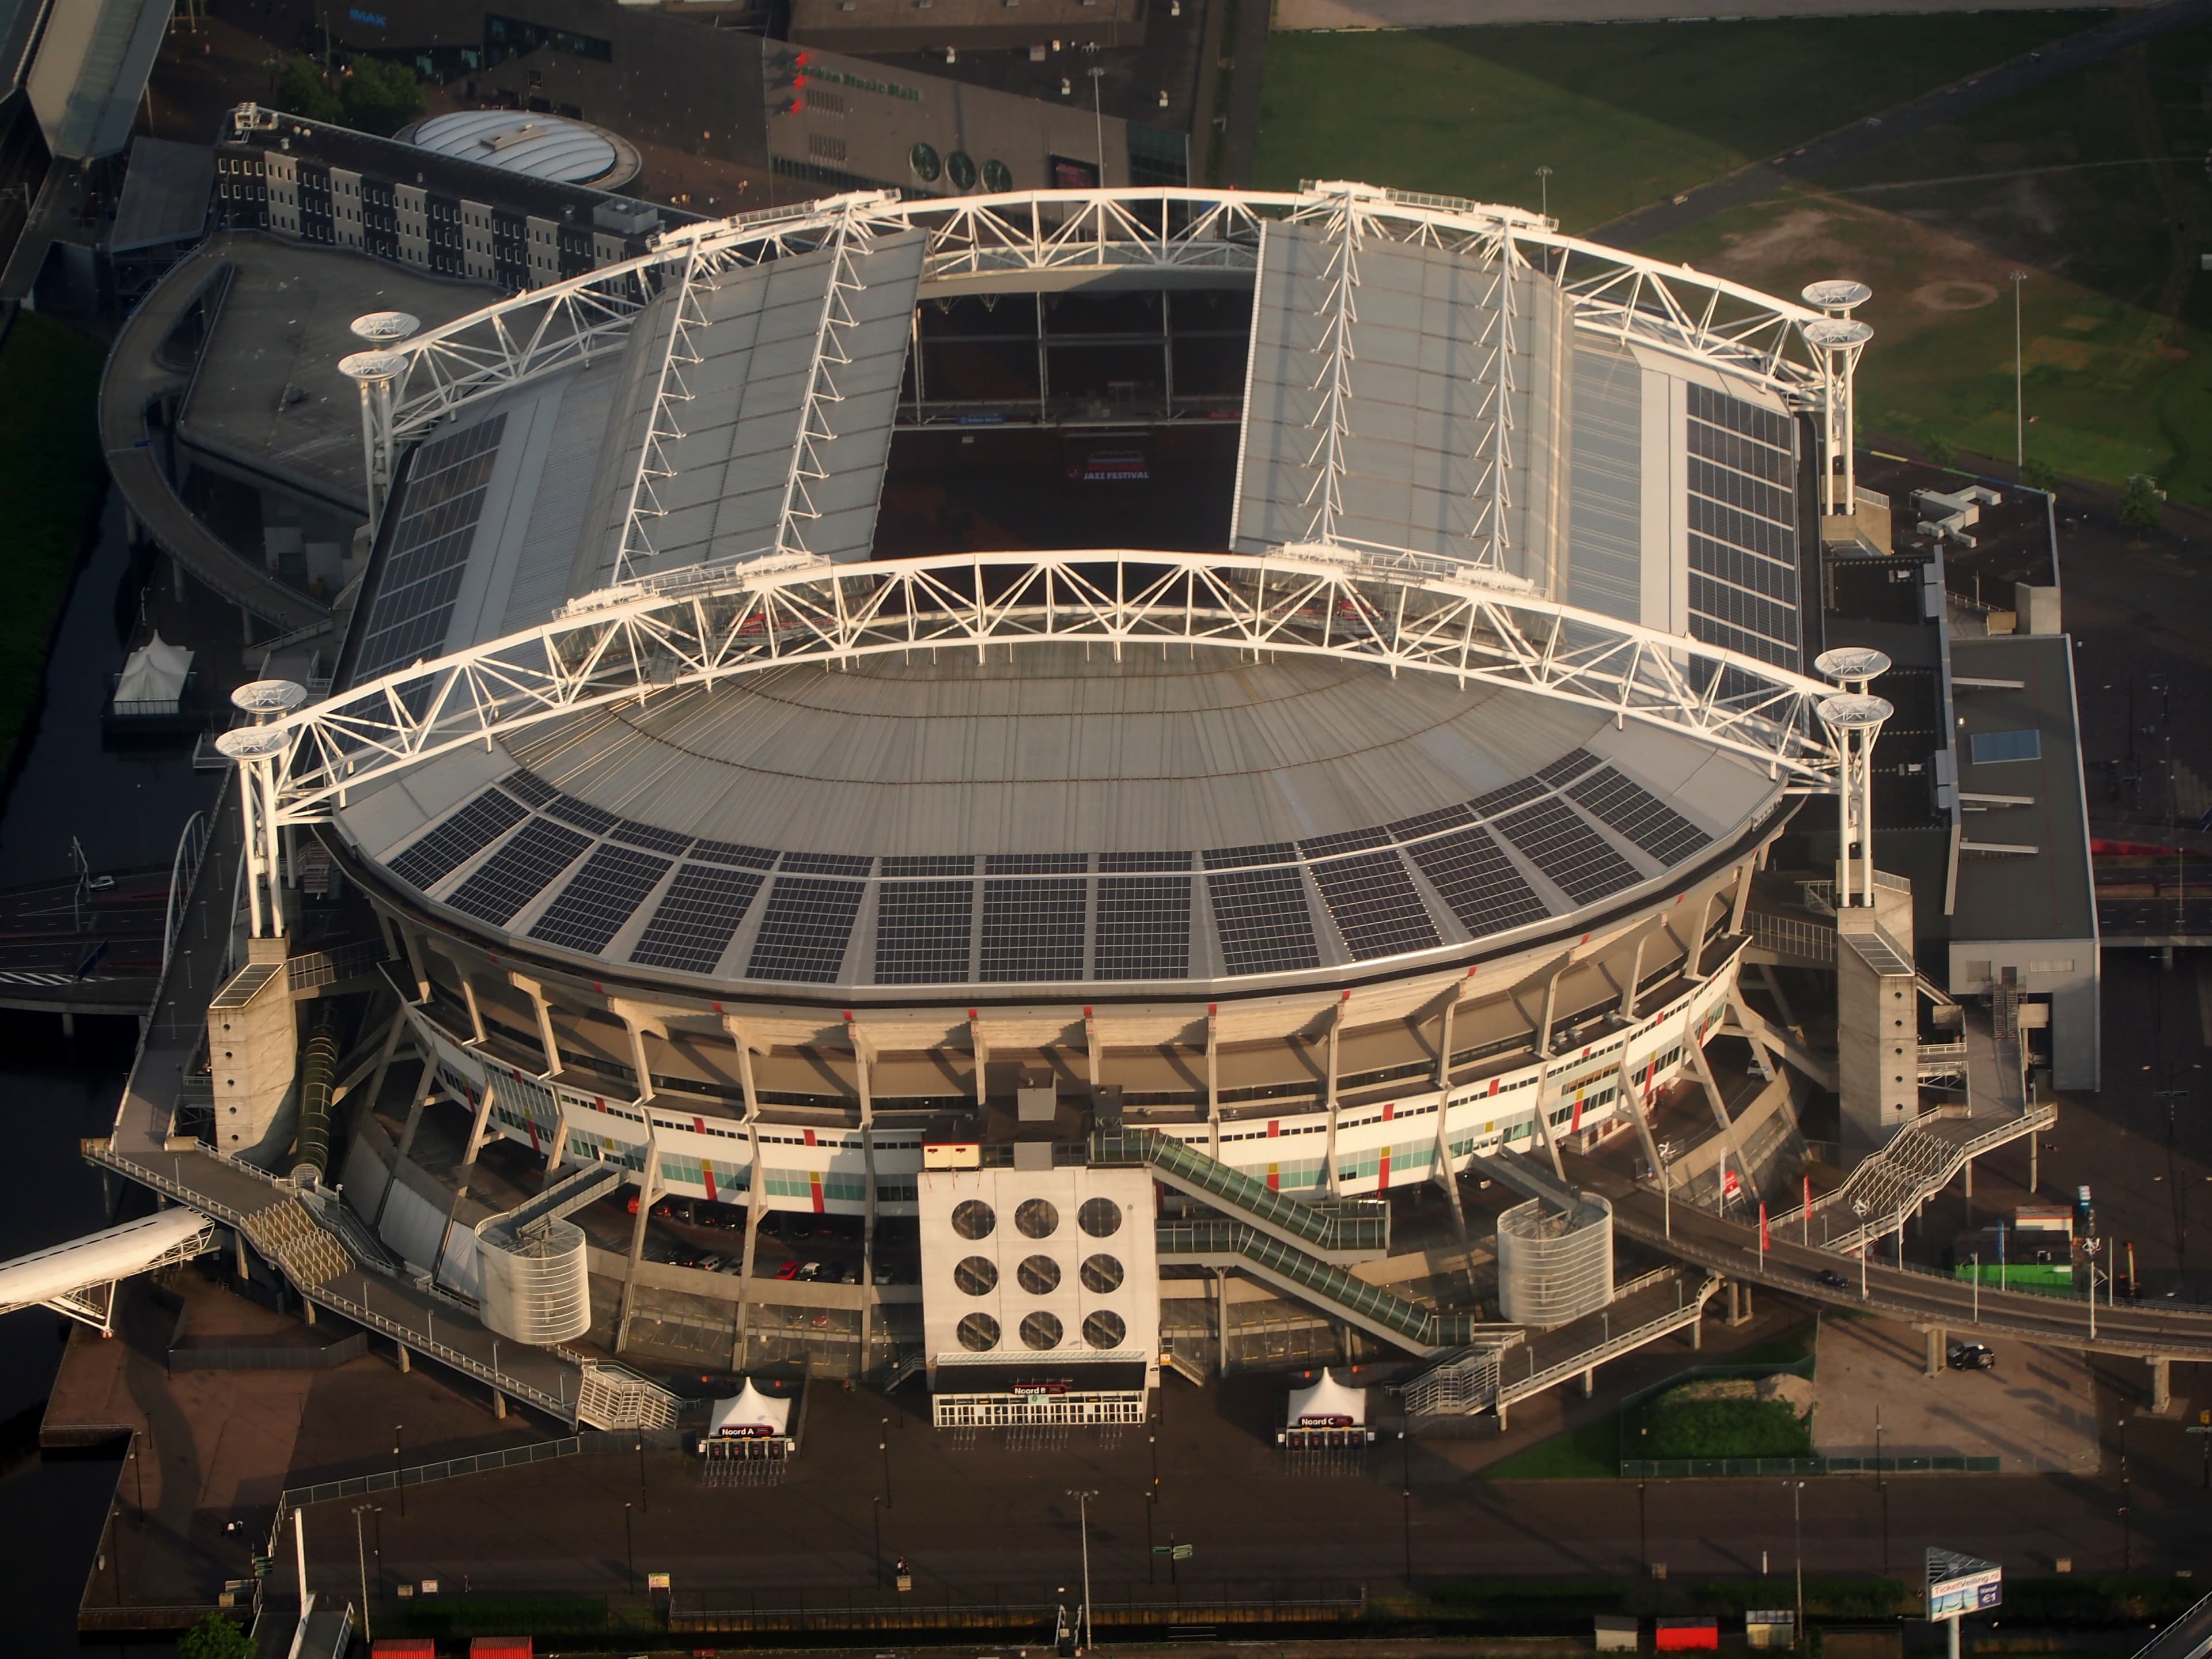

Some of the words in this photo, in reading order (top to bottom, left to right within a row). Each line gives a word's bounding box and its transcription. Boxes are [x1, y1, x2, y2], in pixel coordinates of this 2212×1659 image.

[350, 9, 387, 28] IMAX
[1107, 471, 1149, 479] FESTIVAL
[1934, 1573, 1999, 1594] TicketVeiling.nl
[1982, 1593, 1997, 1604] €1
